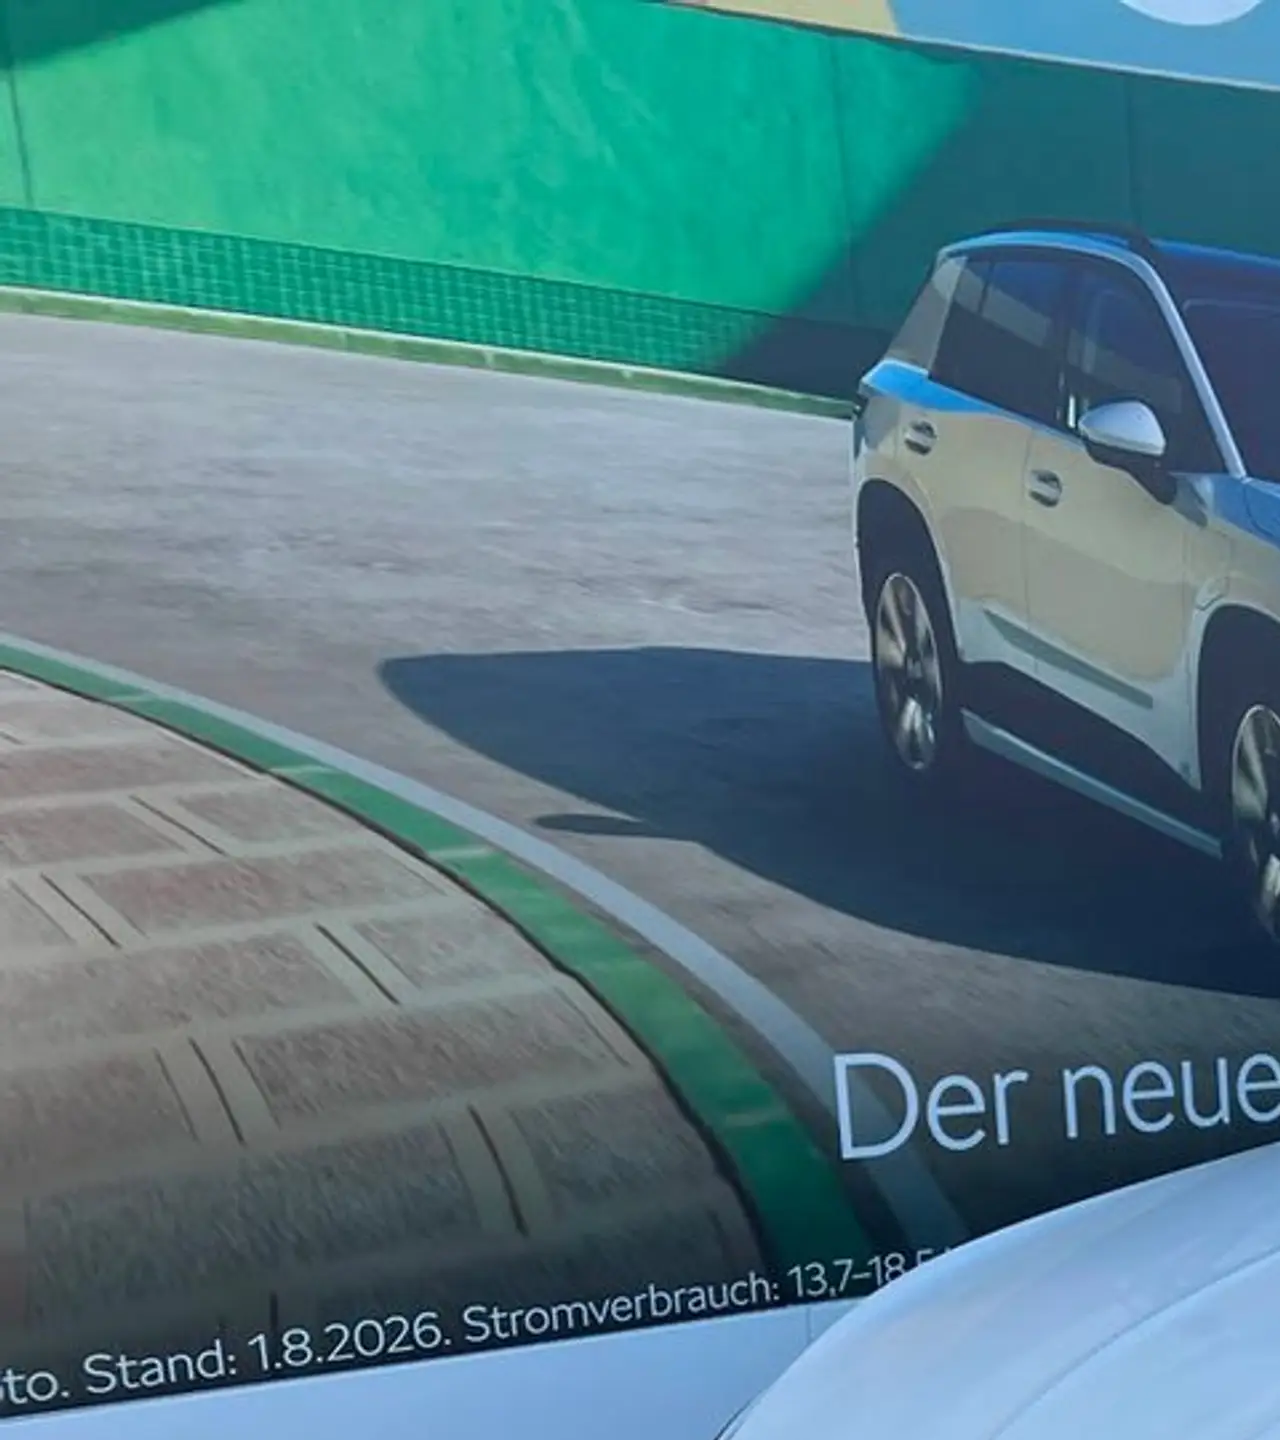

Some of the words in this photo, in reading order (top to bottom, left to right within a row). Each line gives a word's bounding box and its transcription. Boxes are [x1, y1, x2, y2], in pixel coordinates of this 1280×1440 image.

[832, 1052, 1027, 1160] Der
[0, 1367, 70, 1405] to.
[83, 1338, 238, 1394] Stand:
[246, 1311, 453, 1374] 1.8.2026.
[464, 1272, 781, 1344] Stromverbrauch:
